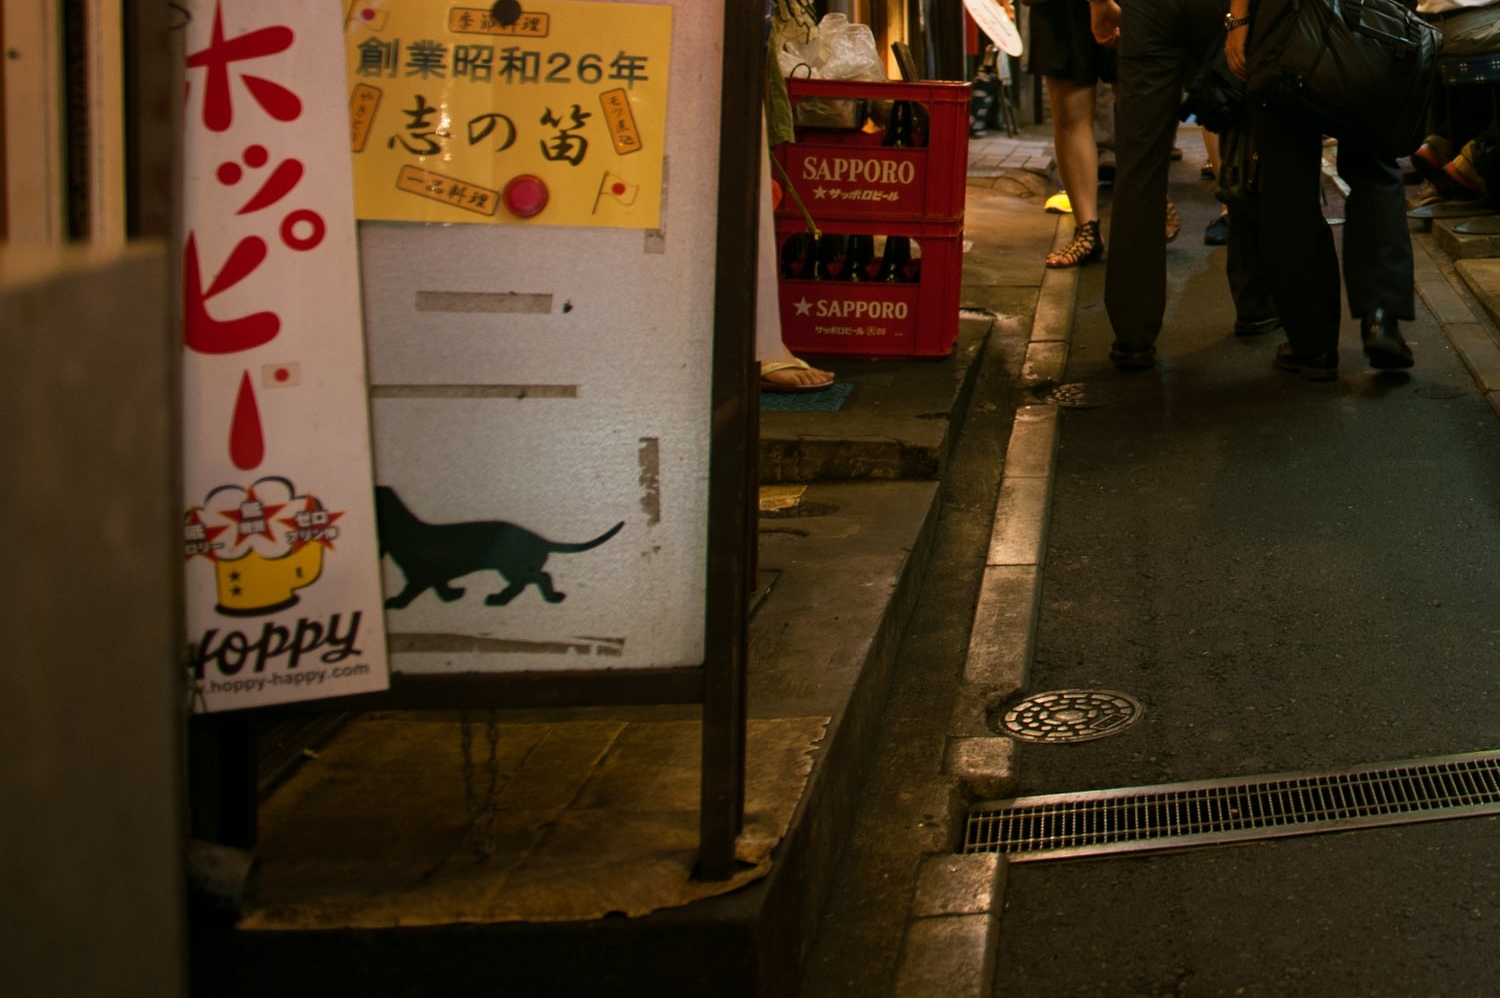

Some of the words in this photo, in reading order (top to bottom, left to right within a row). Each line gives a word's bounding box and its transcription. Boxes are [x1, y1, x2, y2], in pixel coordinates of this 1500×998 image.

[355, 37, 650, 90] 創業昭和26年
[387, 95, 593, 166] 志の笛
[803, 156, 915, 185] SAPPORO
[829, 188, 899, 202] サッポロビール
[816, 299, 909, 320] SAPPORO
[294, 510, 328, 528] ゼロ
